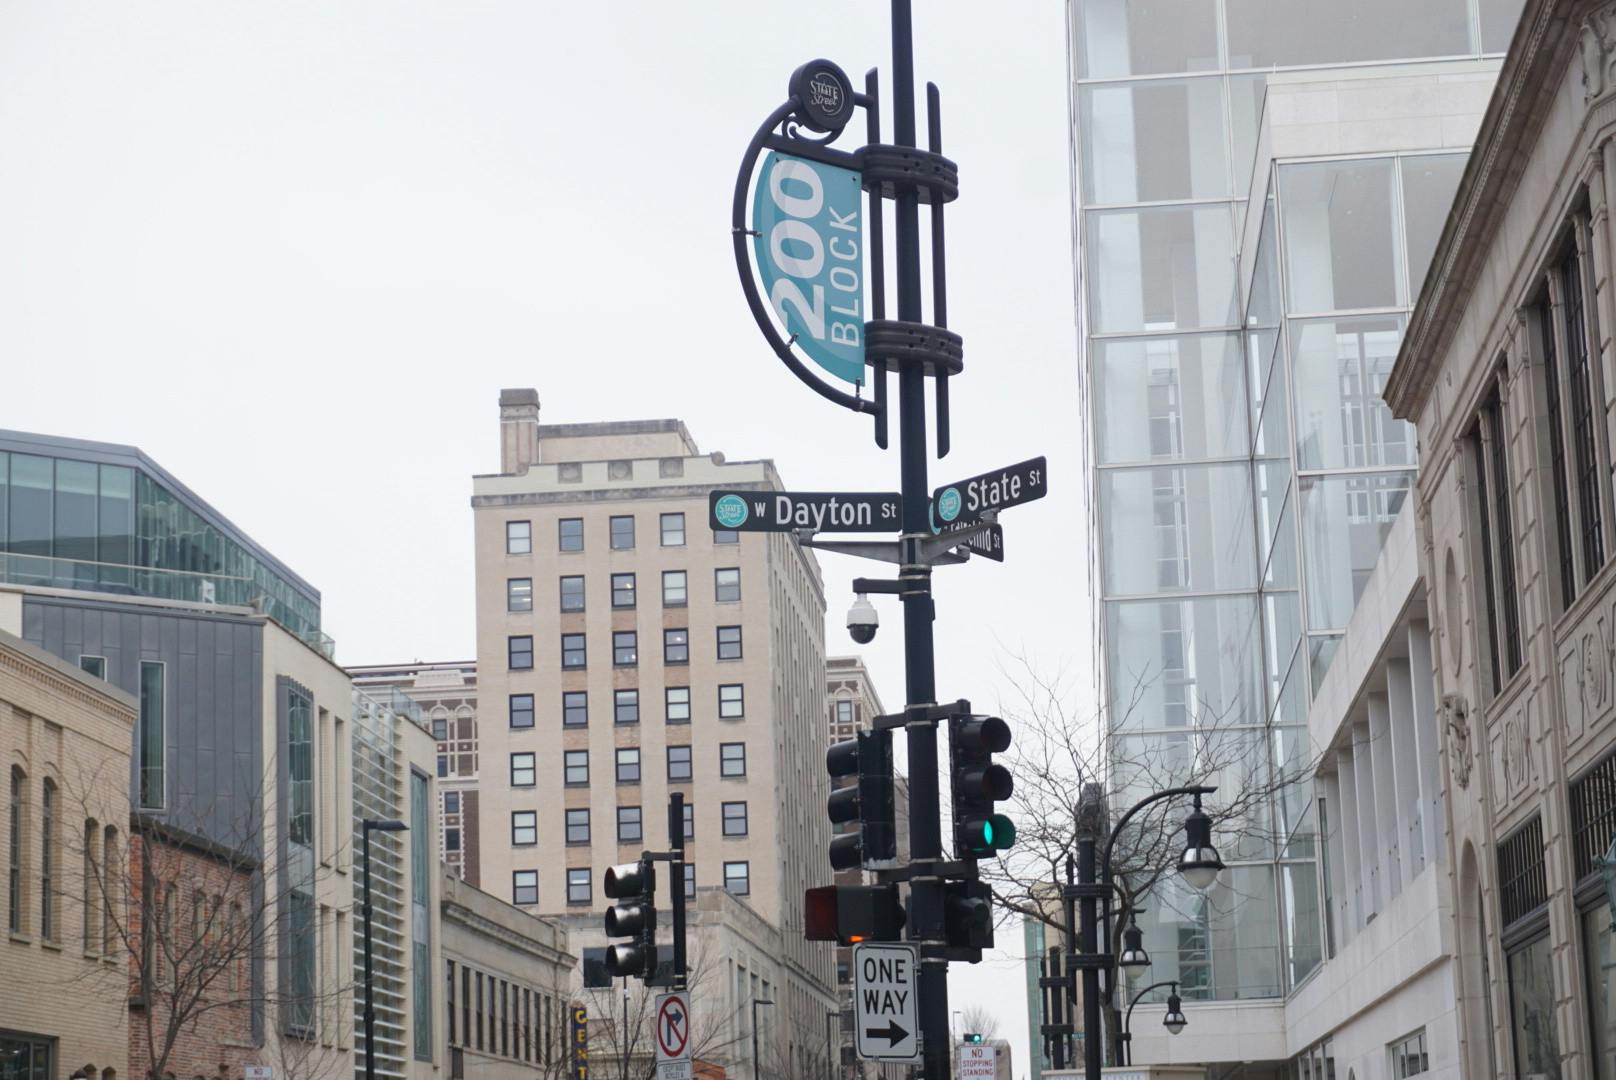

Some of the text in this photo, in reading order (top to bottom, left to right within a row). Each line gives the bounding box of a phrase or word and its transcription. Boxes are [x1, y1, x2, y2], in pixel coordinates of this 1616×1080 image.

[810, 79, 839, 100] STATE
[811, 94, 837, 106] Street
[770, 159, 825, 341] 200
[829, 206, 860, 348] BLOCK
[967, 472, 1021, 512] State
[1029, 469, 1041, 487] St
[755, 496, 897, 532] W Dayton St
[863, 957, 907, 984] ONE
[863, 989, 908, 1015] WAY
[962, 1060, 993, 1068] STOPPING
[971, 1048, 983, 1058] NO
[962, 1069, 994, 1077] STANDING
